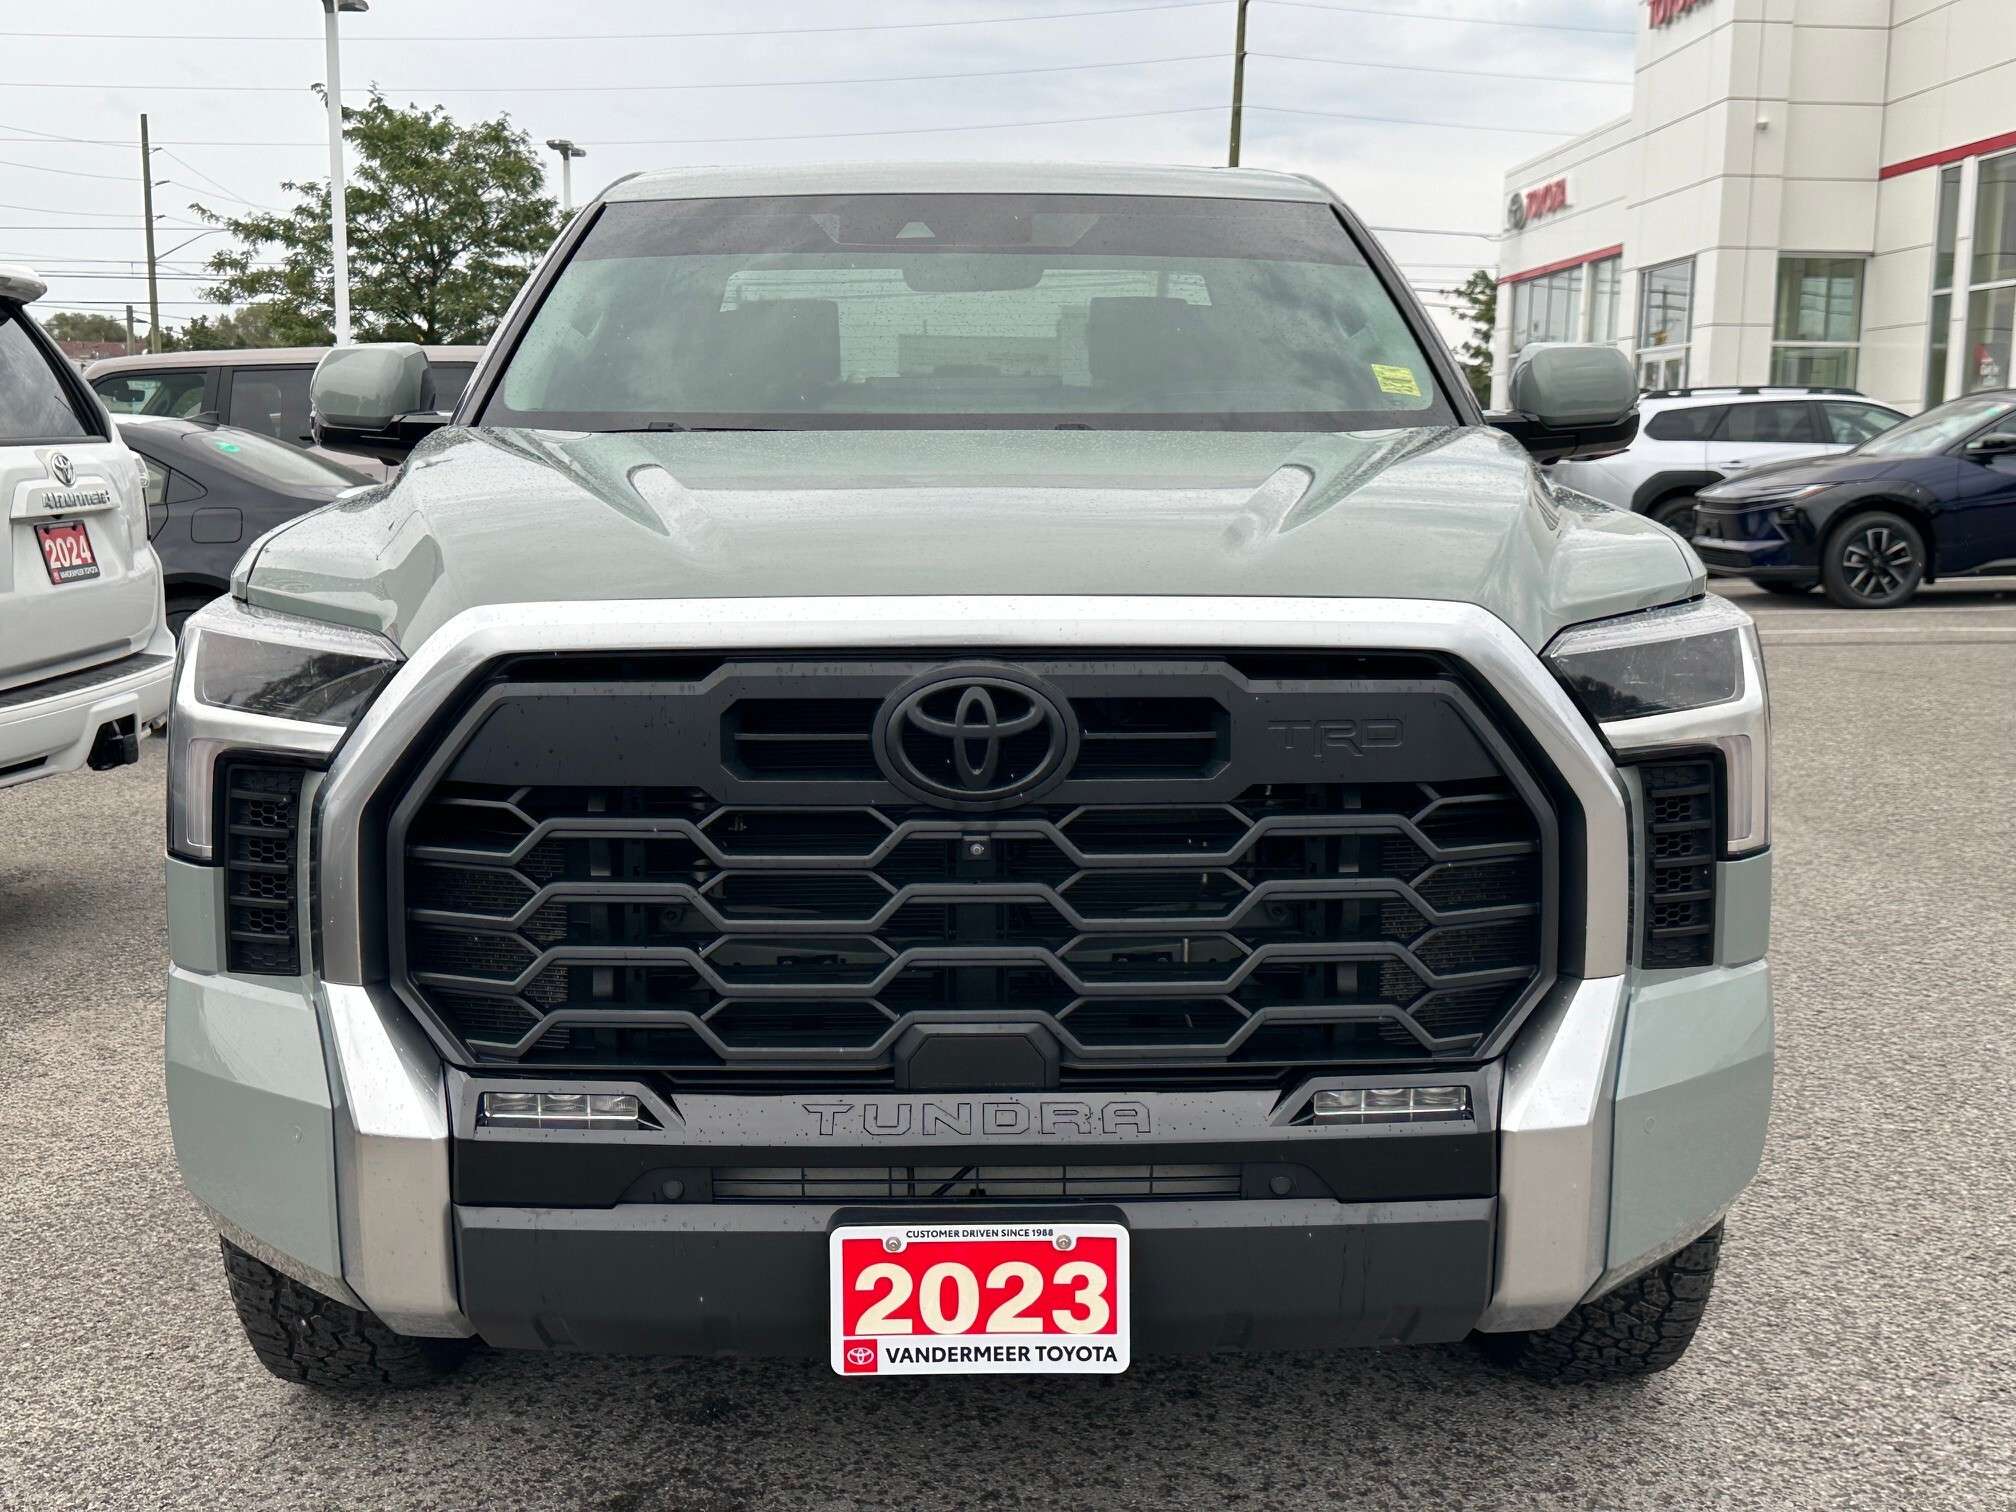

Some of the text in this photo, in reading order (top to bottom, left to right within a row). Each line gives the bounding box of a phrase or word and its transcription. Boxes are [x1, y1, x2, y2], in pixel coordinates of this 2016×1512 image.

[45, 535, 93, 568] 2024
[1267, 718, 1405, 758] TRD
[801, 1101, 1152, 1136] TUNDRA
[906, 1229, 1054, 1238] CUSTOMER DRIVEN SINCE 1988
[854, 1261, 1110, 1335] 2023
[886, 1346, 1118, 1363] VANDERMEER TOYOTA
